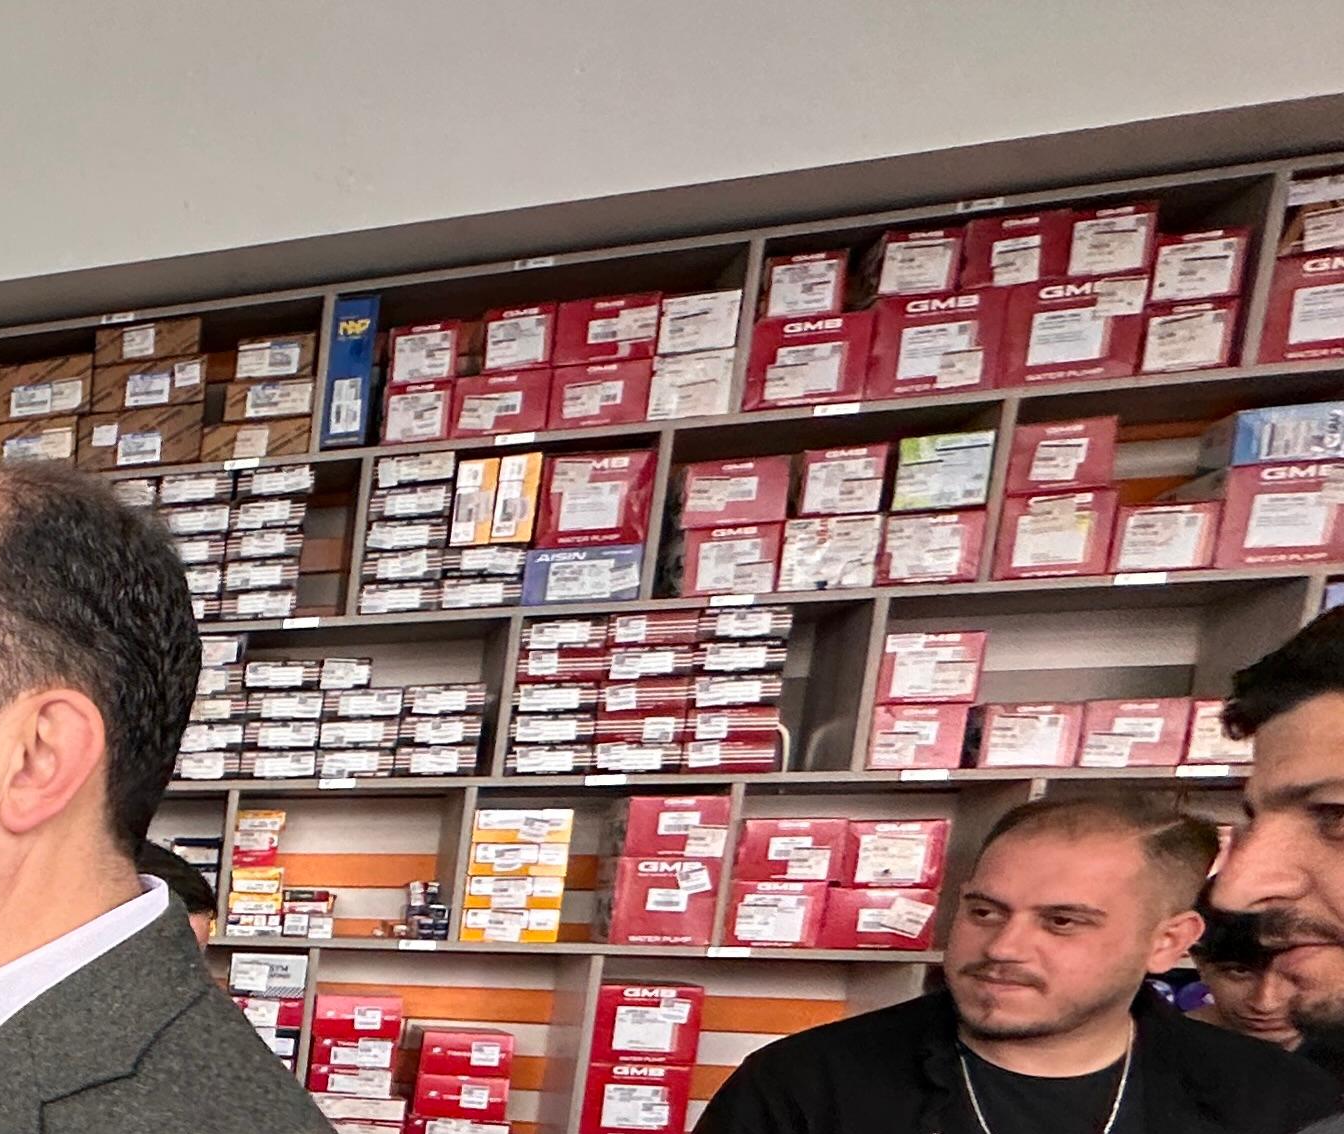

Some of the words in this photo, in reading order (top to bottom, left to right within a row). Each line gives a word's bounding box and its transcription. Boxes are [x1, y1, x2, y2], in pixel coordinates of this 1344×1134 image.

[905, 294, 980, 313] GMB
[782, 318, 844, 334] GMB
[591, 456, 631, 469] MB
[535, 550, 588, 563] AISIN
[622, 987, 678, 999] GMB
[612, 1065, 665, 1078] GMB
